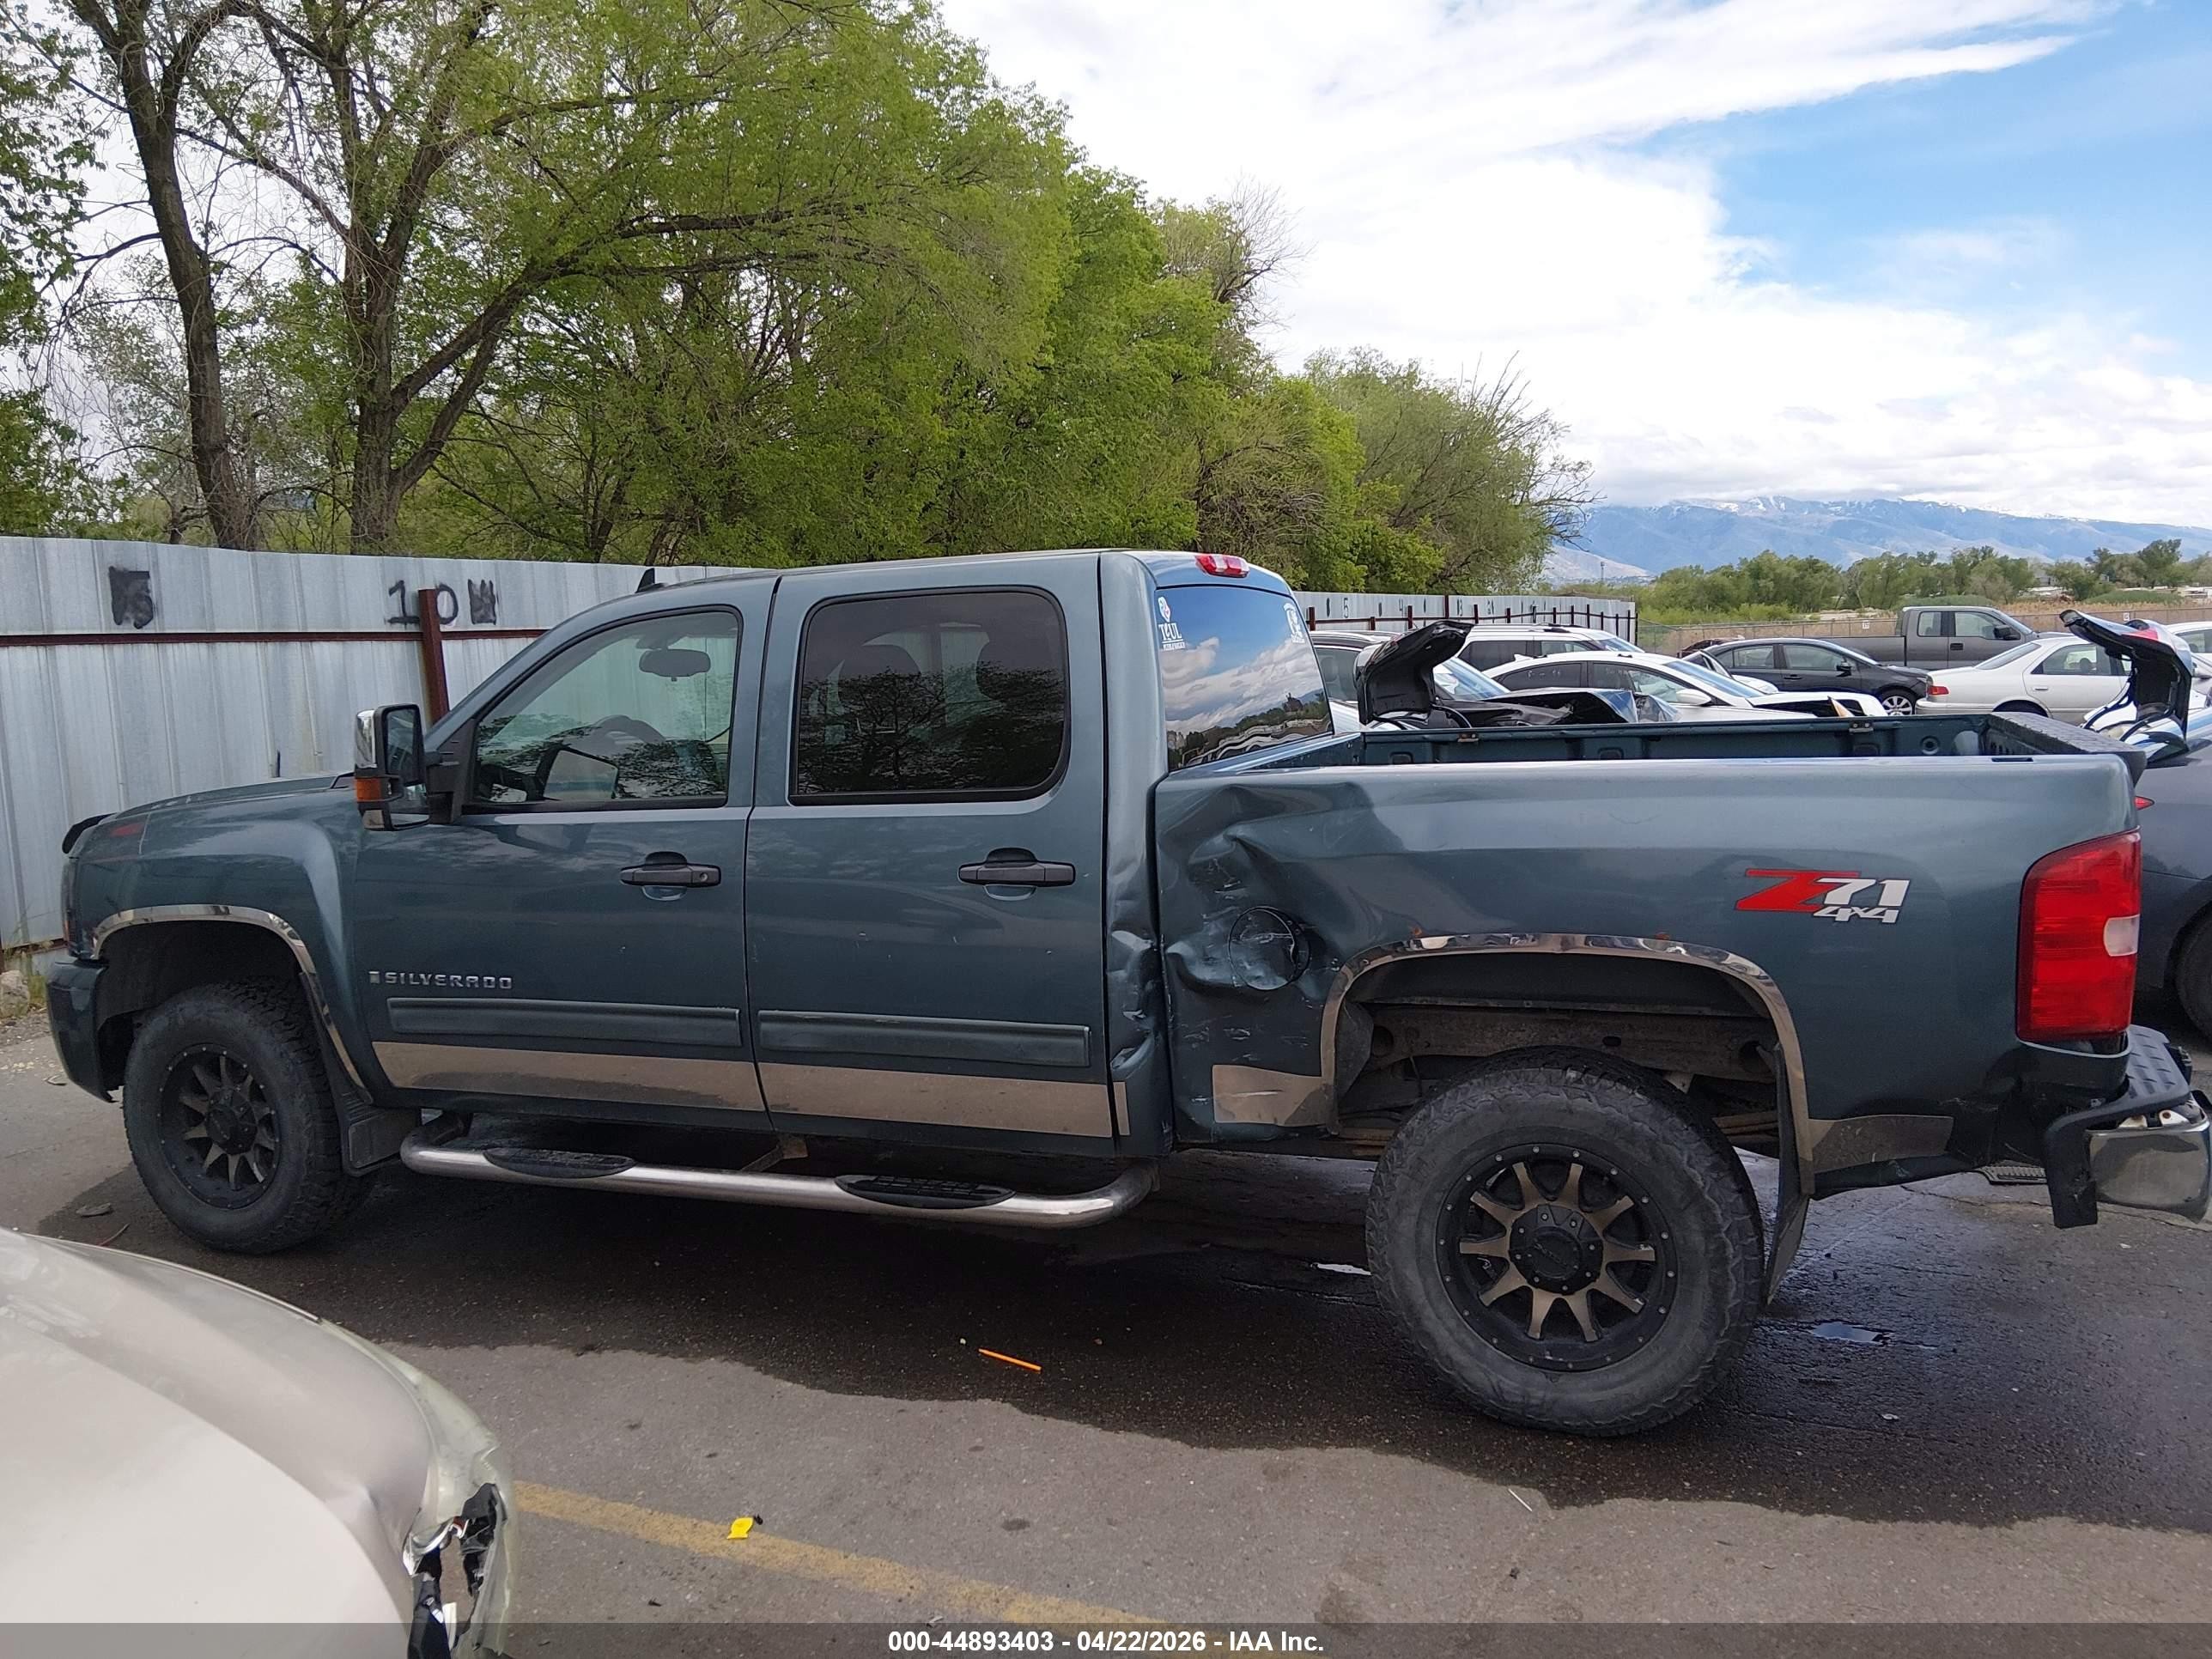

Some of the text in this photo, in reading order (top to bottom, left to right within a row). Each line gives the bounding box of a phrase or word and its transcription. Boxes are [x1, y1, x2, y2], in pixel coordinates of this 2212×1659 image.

[387, 580, 459, 629] 10
[1735, 867, 1911, 913] Z71
[385, 971, 513, 989] SILVERADO
